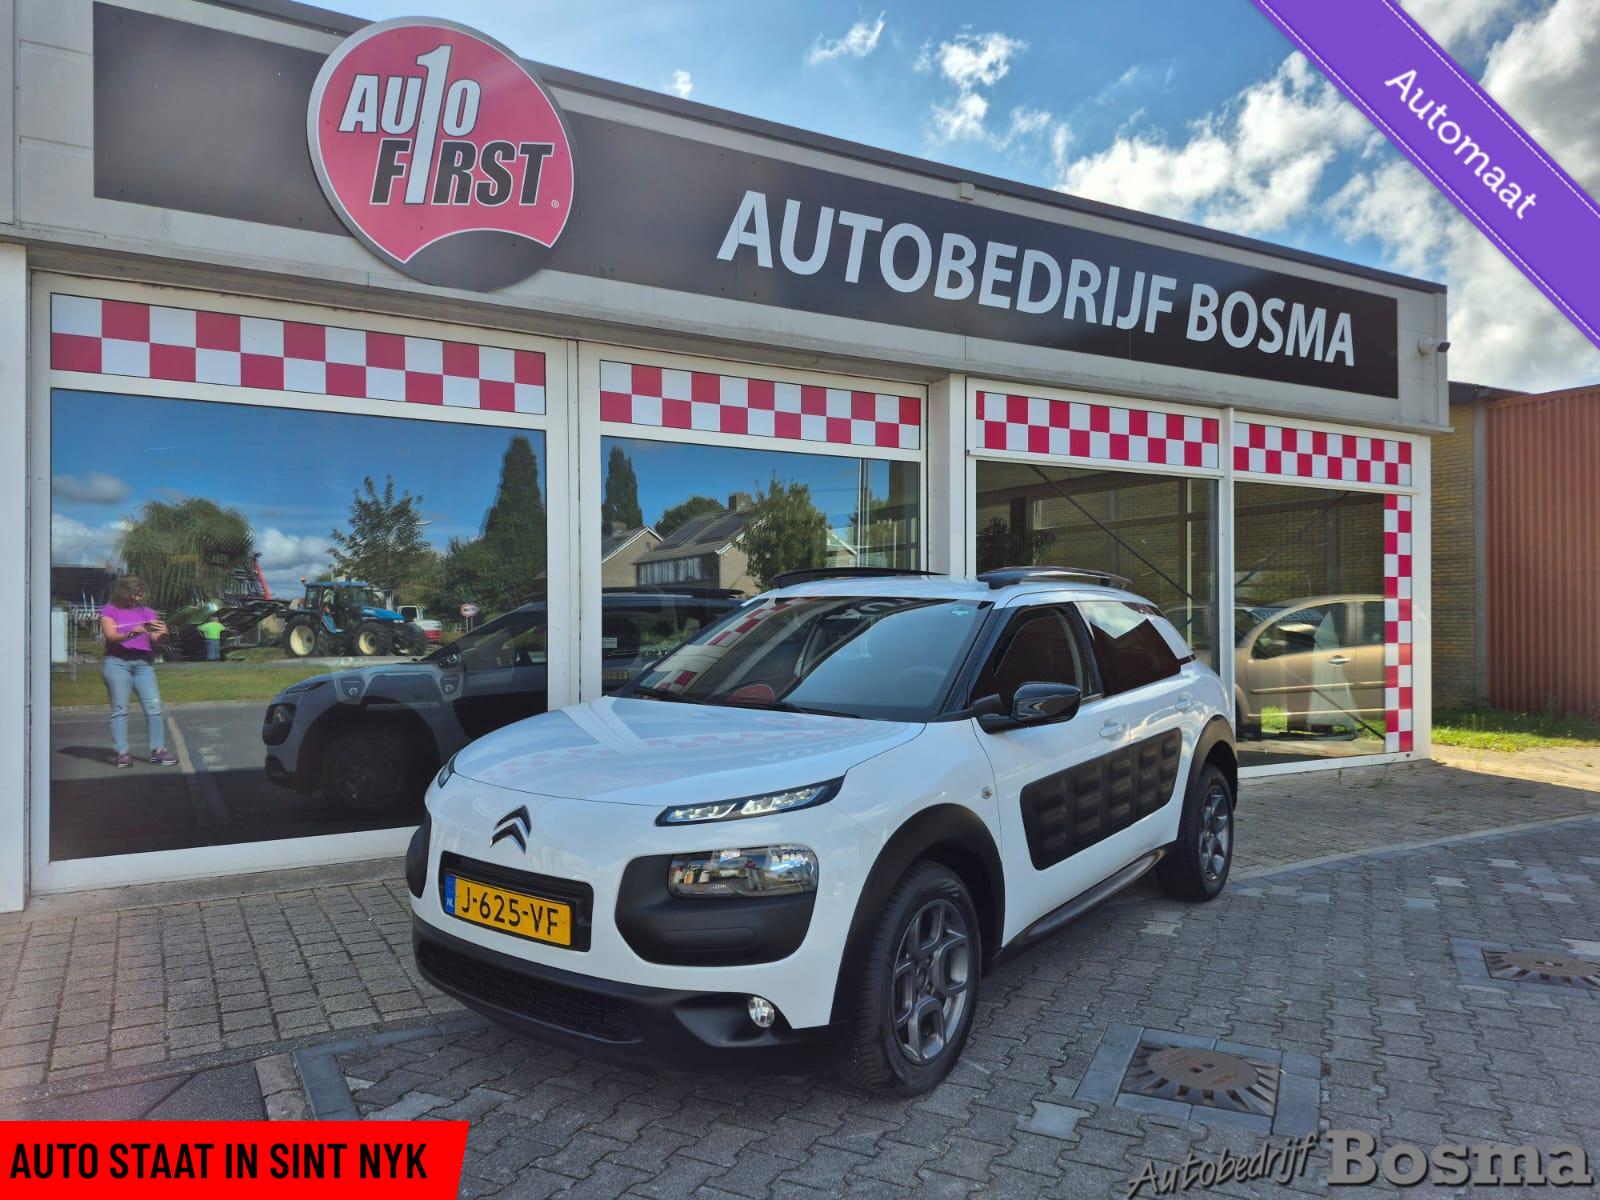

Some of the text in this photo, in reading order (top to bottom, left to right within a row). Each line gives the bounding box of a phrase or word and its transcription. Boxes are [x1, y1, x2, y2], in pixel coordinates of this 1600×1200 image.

[716, 189, 1355, 367] AUTOBEDRIJF BOSMA
[461, 887, 559, 936] J-625-VF
